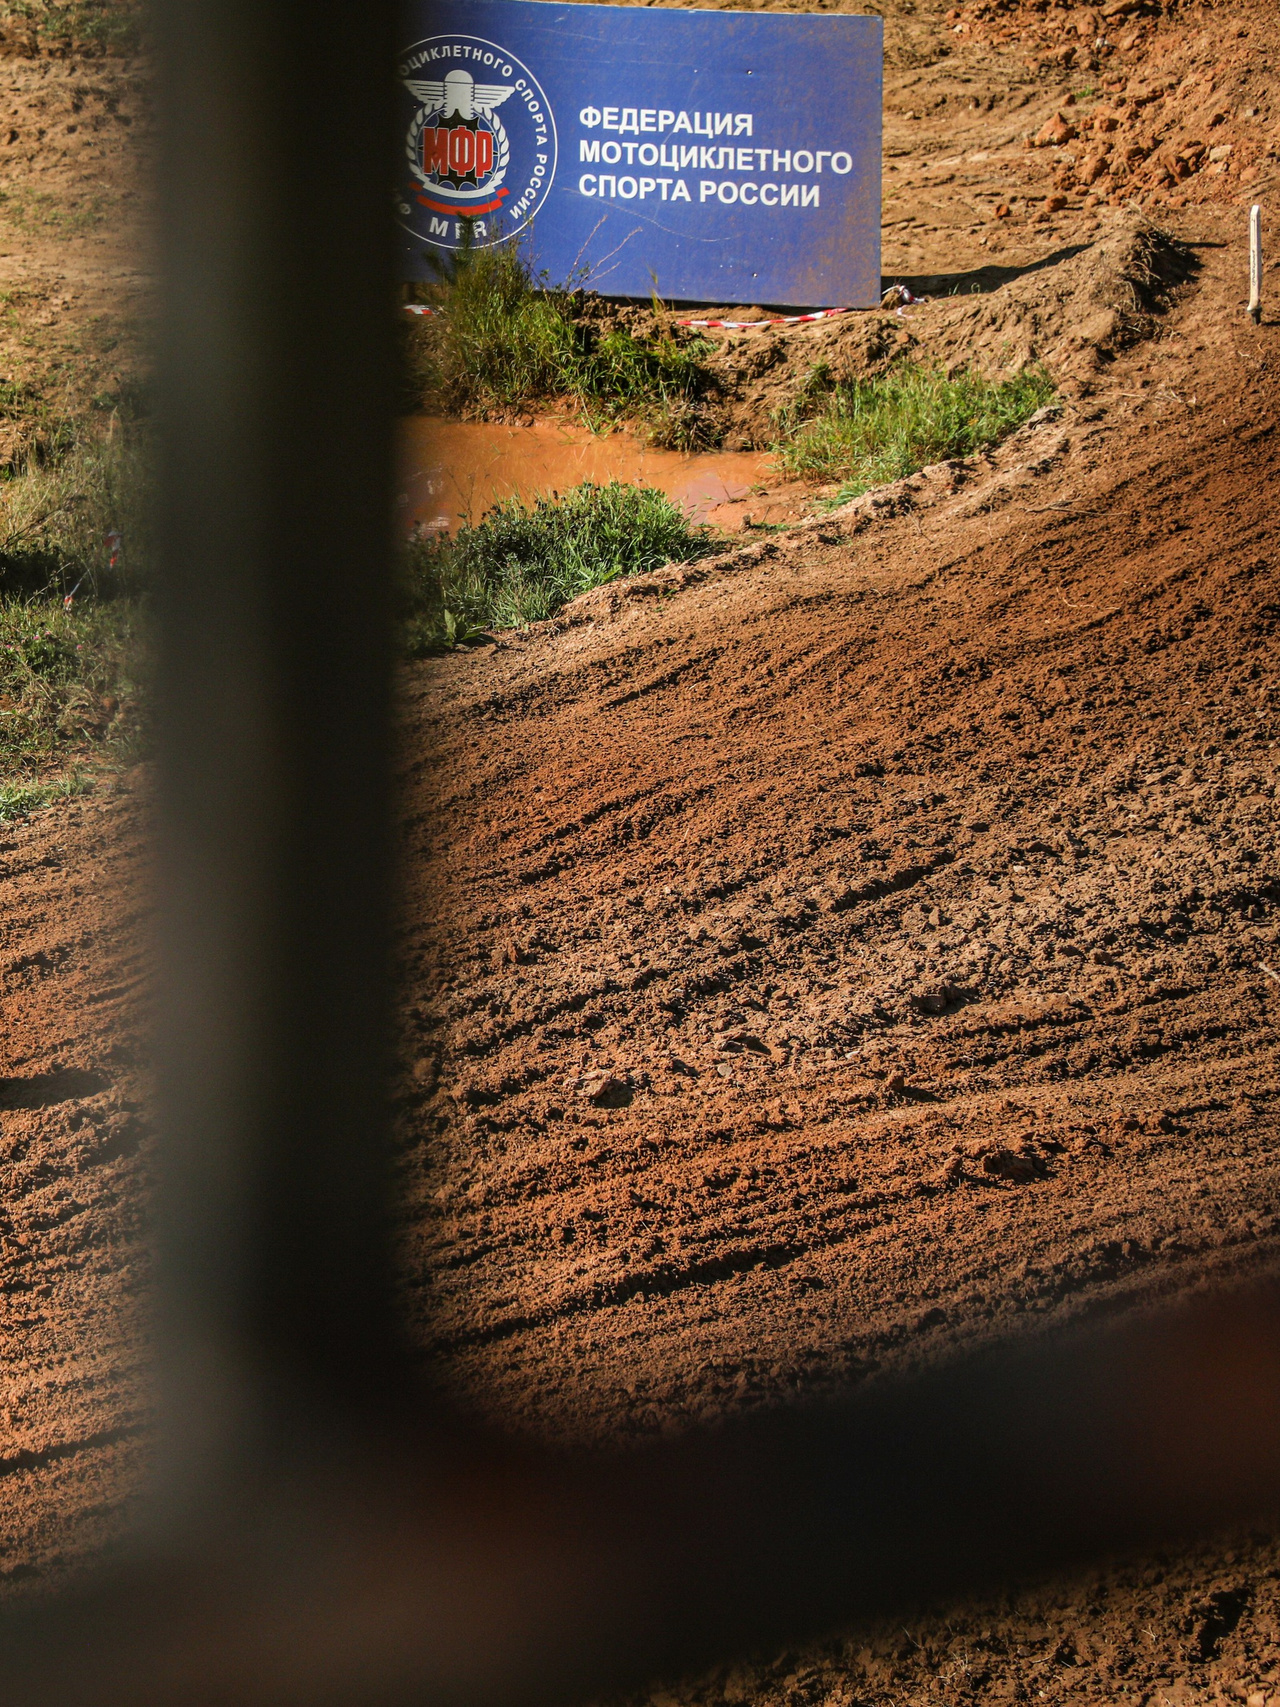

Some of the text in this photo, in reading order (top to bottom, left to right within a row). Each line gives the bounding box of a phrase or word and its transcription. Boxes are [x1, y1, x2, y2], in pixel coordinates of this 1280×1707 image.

[515, 79, 548, 146] СПОРТА
[579, 106, 753, 139] ФЕДЕРАЦИЯ
[423, 126, 494, 178] МФР
[579, 140, 853, 174] МОТОЦИКЛЕТНОГО
[510, 153, 548, 220] РОССИИ
[578, 174, 820, 207] СПОРТА РОССИИ
